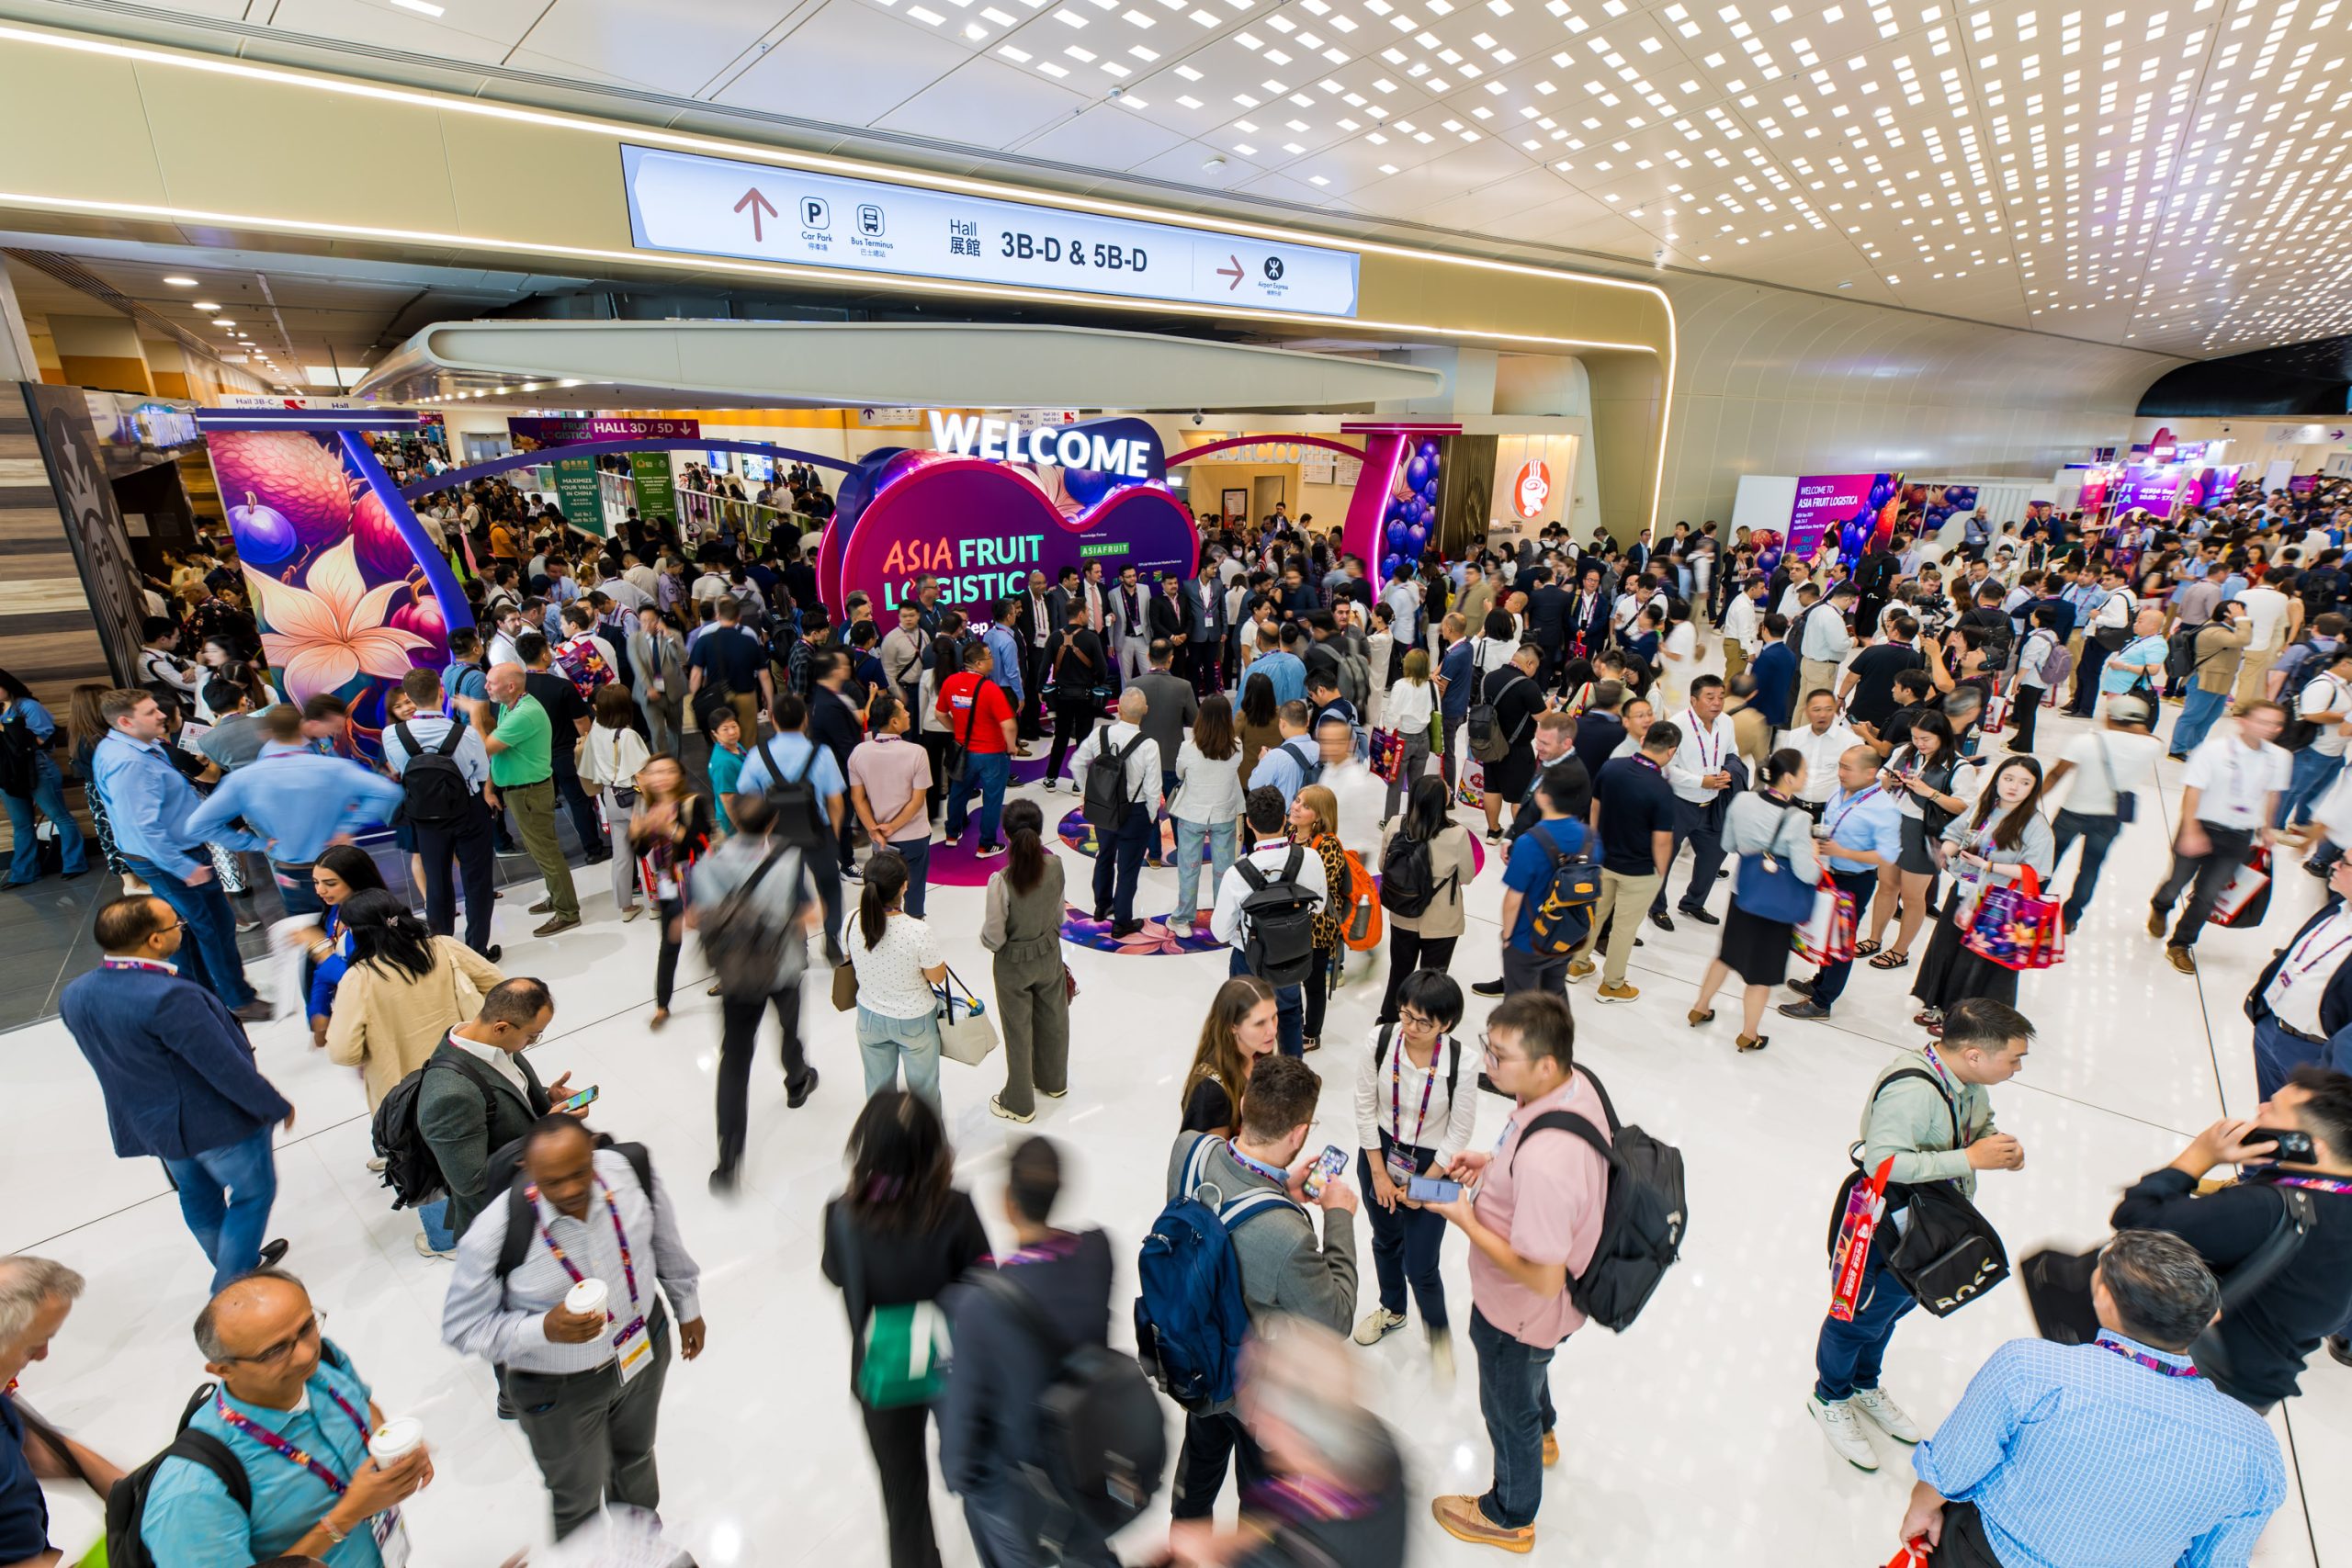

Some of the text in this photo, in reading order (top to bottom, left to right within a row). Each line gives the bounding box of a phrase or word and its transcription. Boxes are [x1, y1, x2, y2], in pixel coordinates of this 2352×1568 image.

[808, 202, 821, 223] P
[950, 219, 977, 236] Hall
[801, 231, 833, 242] Car Park
[851, 236, 894, 249] Bus Terminus
[950, 236, 980, 257] 展館
[1001, 231, 1148, 273] 3B-D & 5B-D
[235, 397, 253, 405] Hall
[331, 401, 349, 410] Hall
[561, 422, 590, 431] FRUIT
[594, 423, 628, 434] HALL
[630, 422, 649, 434] 3D
[657, 423, 674, 434] 5D
[928, 409, 1152, 479] WELCOME
[1801, 485, 1835, 495] WELCOME TO
[1798, 496, 1858, 508] ASIA FRUIT LOGISTICA
[882, 534, 1045, 575] ASIA FRUIT
[1082, 544, 1128, 556] ASIAFRUIT
[884, 569, 1041, 612] LGISTIC
